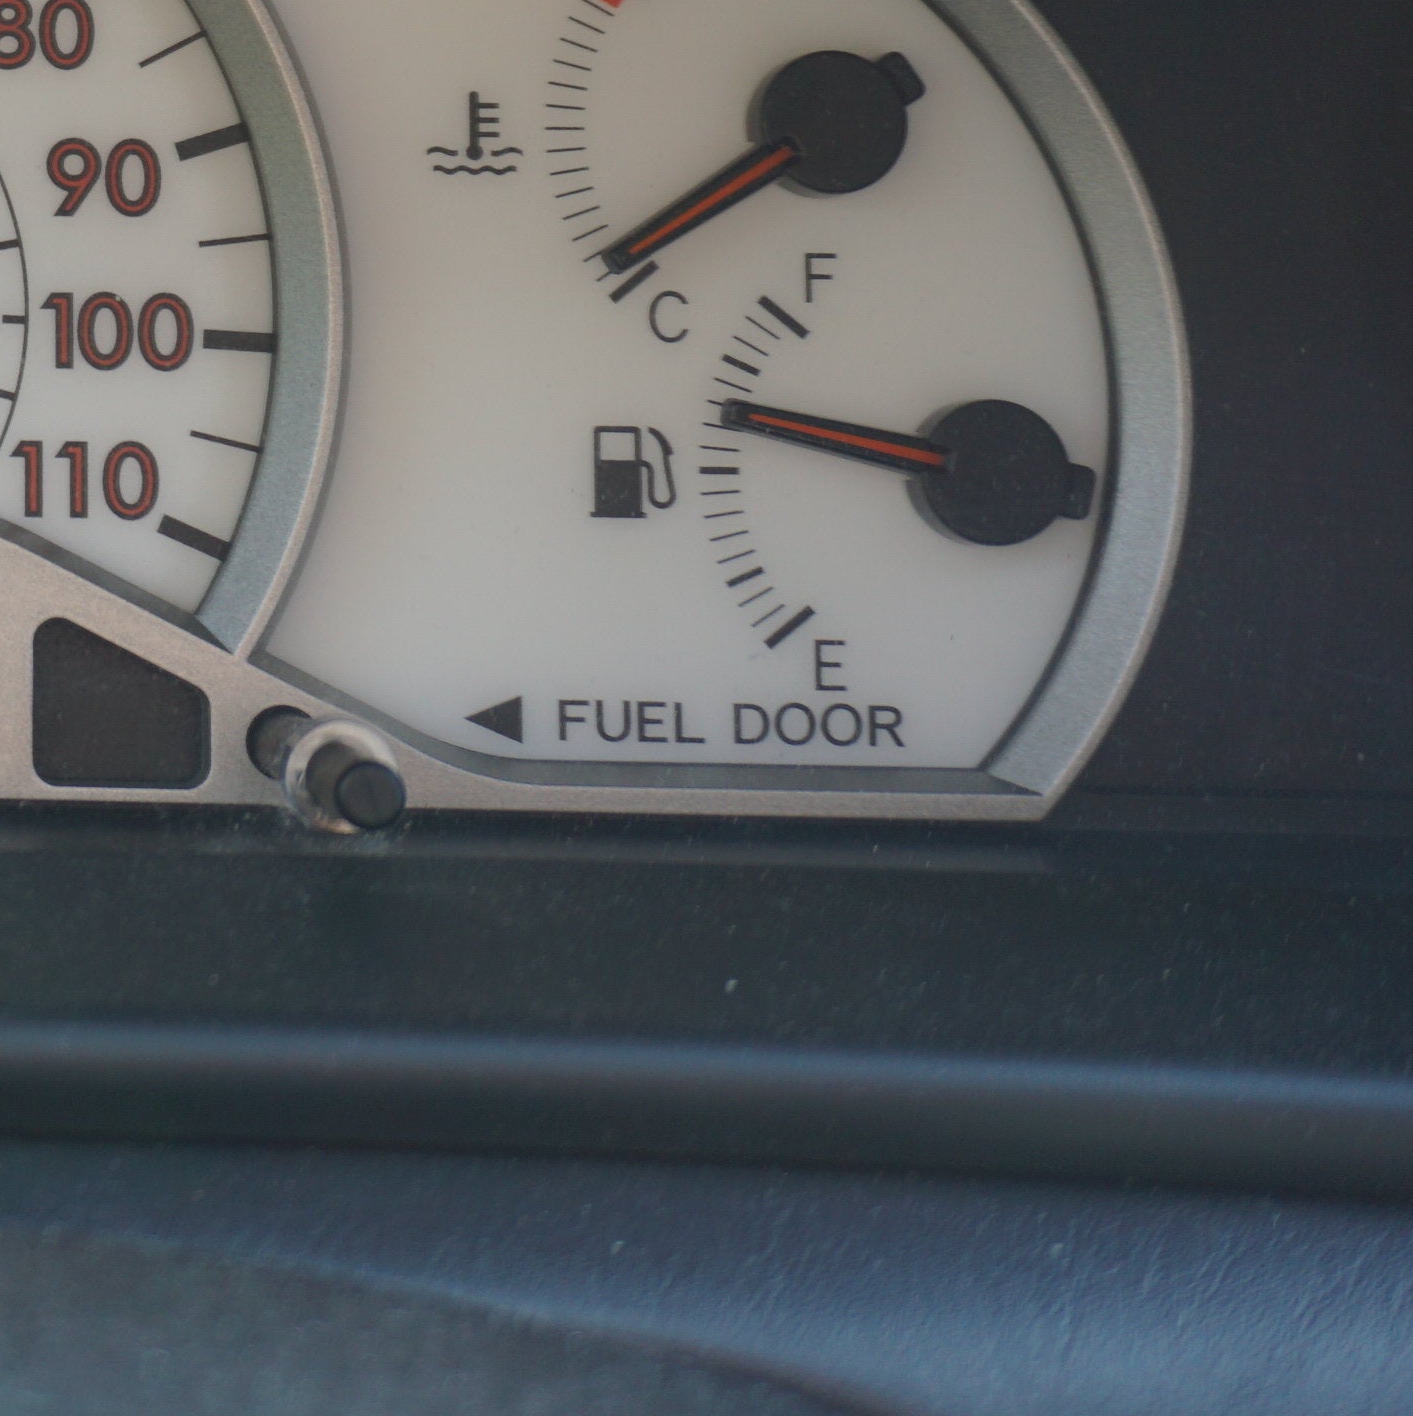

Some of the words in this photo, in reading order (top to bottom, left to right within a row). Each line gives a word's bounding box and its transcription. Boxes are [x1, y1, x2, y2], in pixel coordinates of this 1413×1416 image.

[46, 138, 161, 217] 90
[805, 253, 836, 303] F
[41, 292, 194, 371] 100
[649, 290, 688, 343] C
[13, 439, 158, 519] 110
[815, 640, 847, 691] E
[559, 700, 705, 744] FUEL
[734, 703, 904, 747] DOOR
